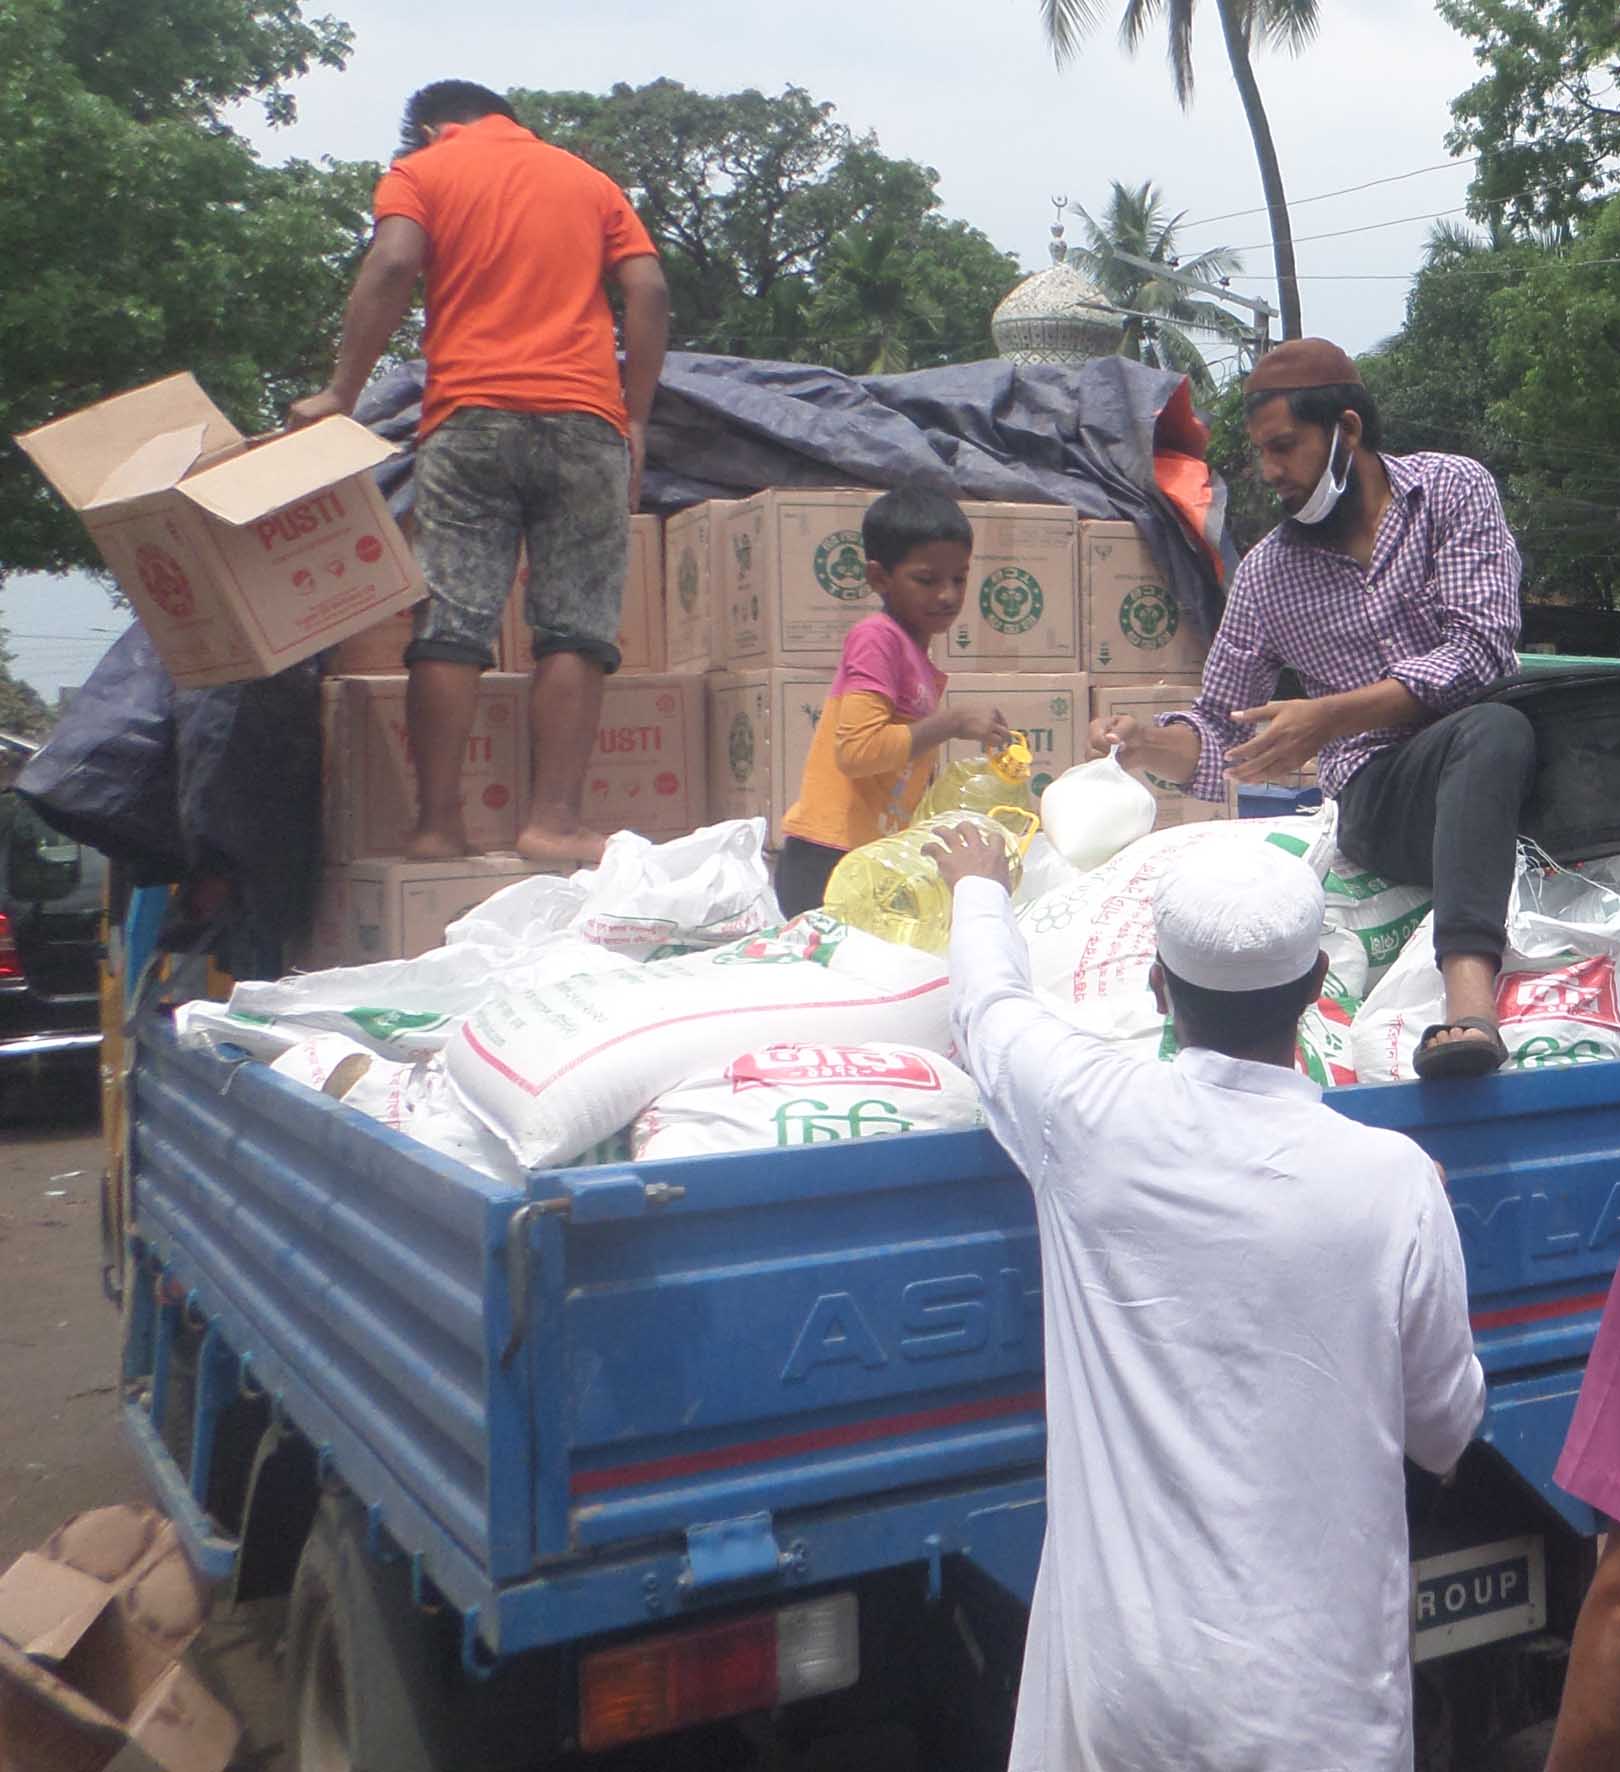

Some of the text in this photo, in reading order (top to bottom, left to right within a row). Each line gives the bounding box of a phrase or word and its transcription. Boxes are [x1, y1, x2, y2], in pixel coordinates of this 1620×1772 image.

[257, 491, 345, 551] PUSTI
[599, 726, 662, 753] USTI
[1416, 1571, 1517, 1620] ROUP
